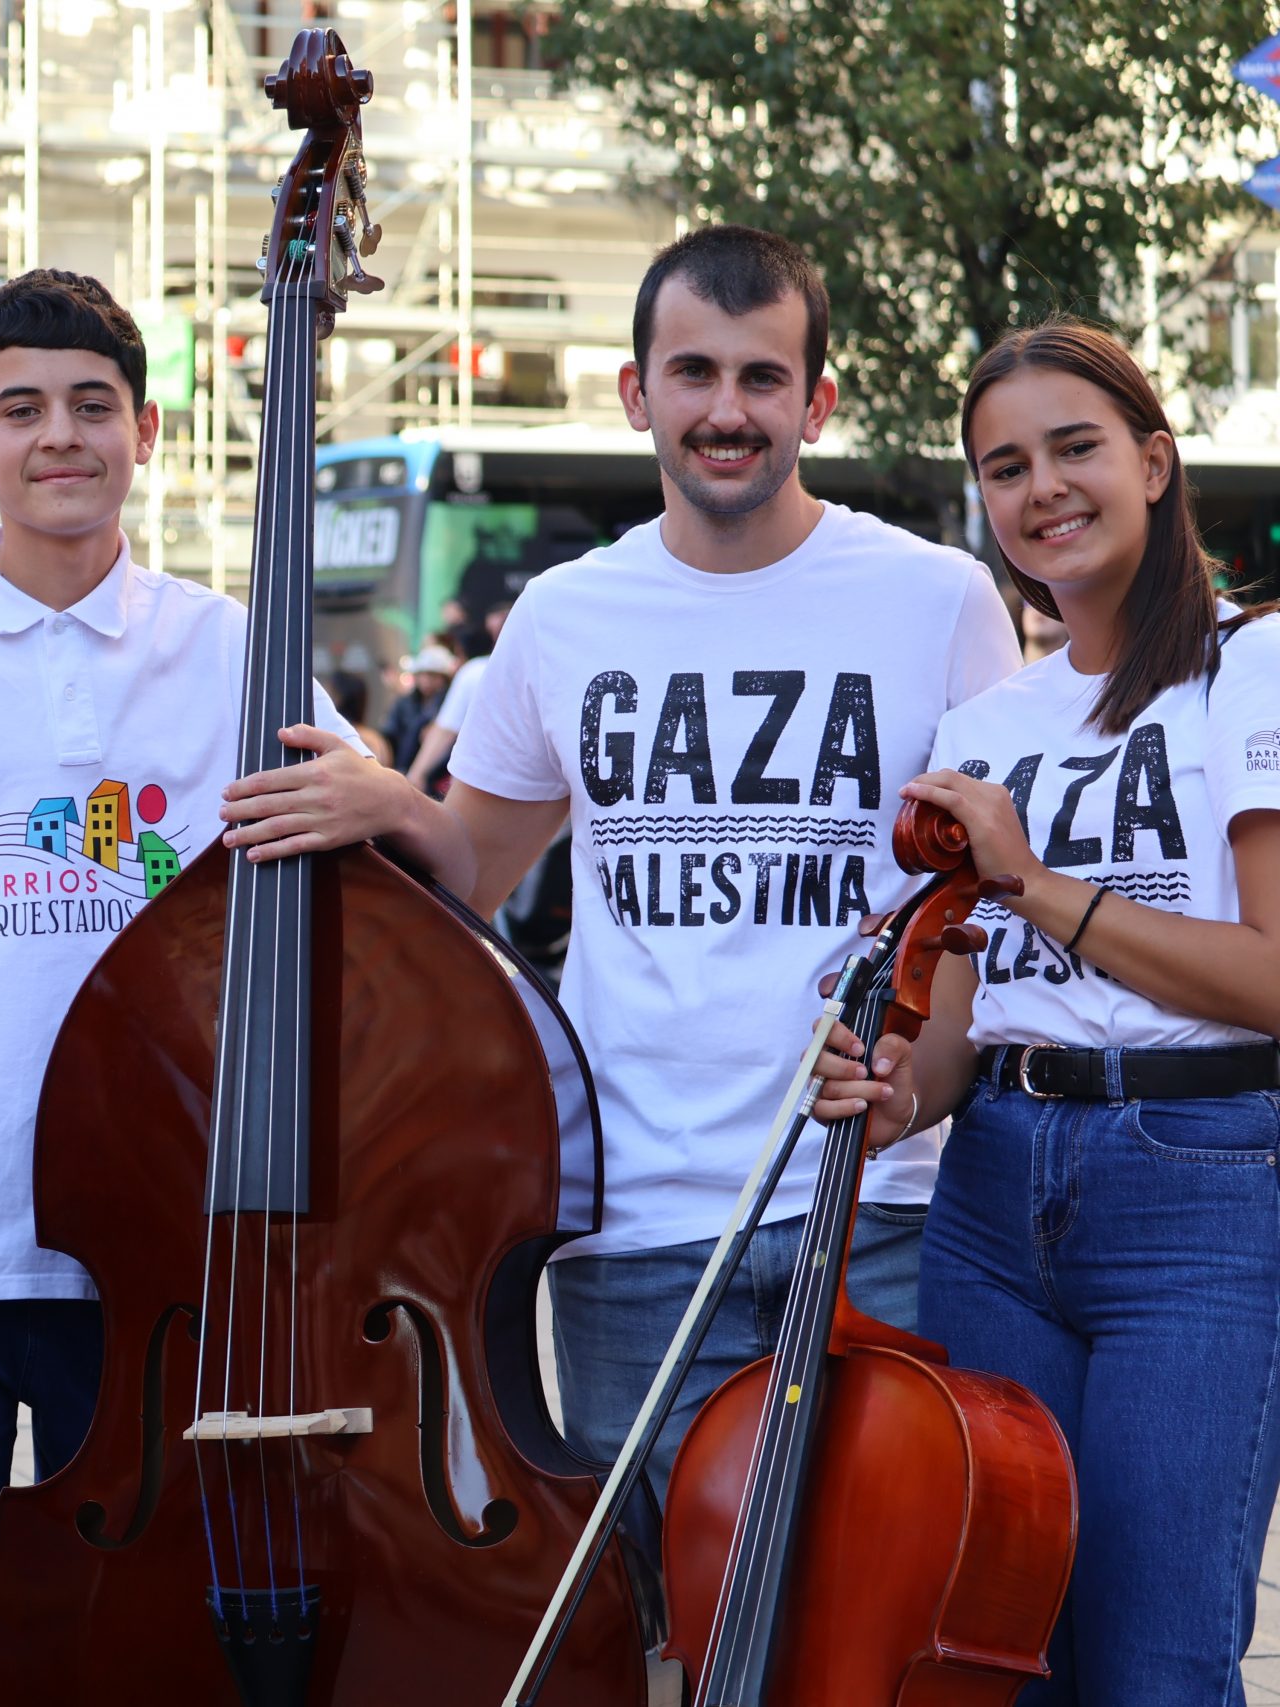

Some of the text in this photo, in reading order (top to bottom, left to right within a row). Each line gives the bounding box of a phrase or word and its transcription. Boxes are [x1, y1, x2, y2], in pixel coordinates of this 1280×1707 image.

[580, 670, 881, 810] GAZA
[1246, 750, 1279, 760] BARR
[1246, 758, 1280, 772] ORQUE
[958, 722, 1188, 869] AZA
